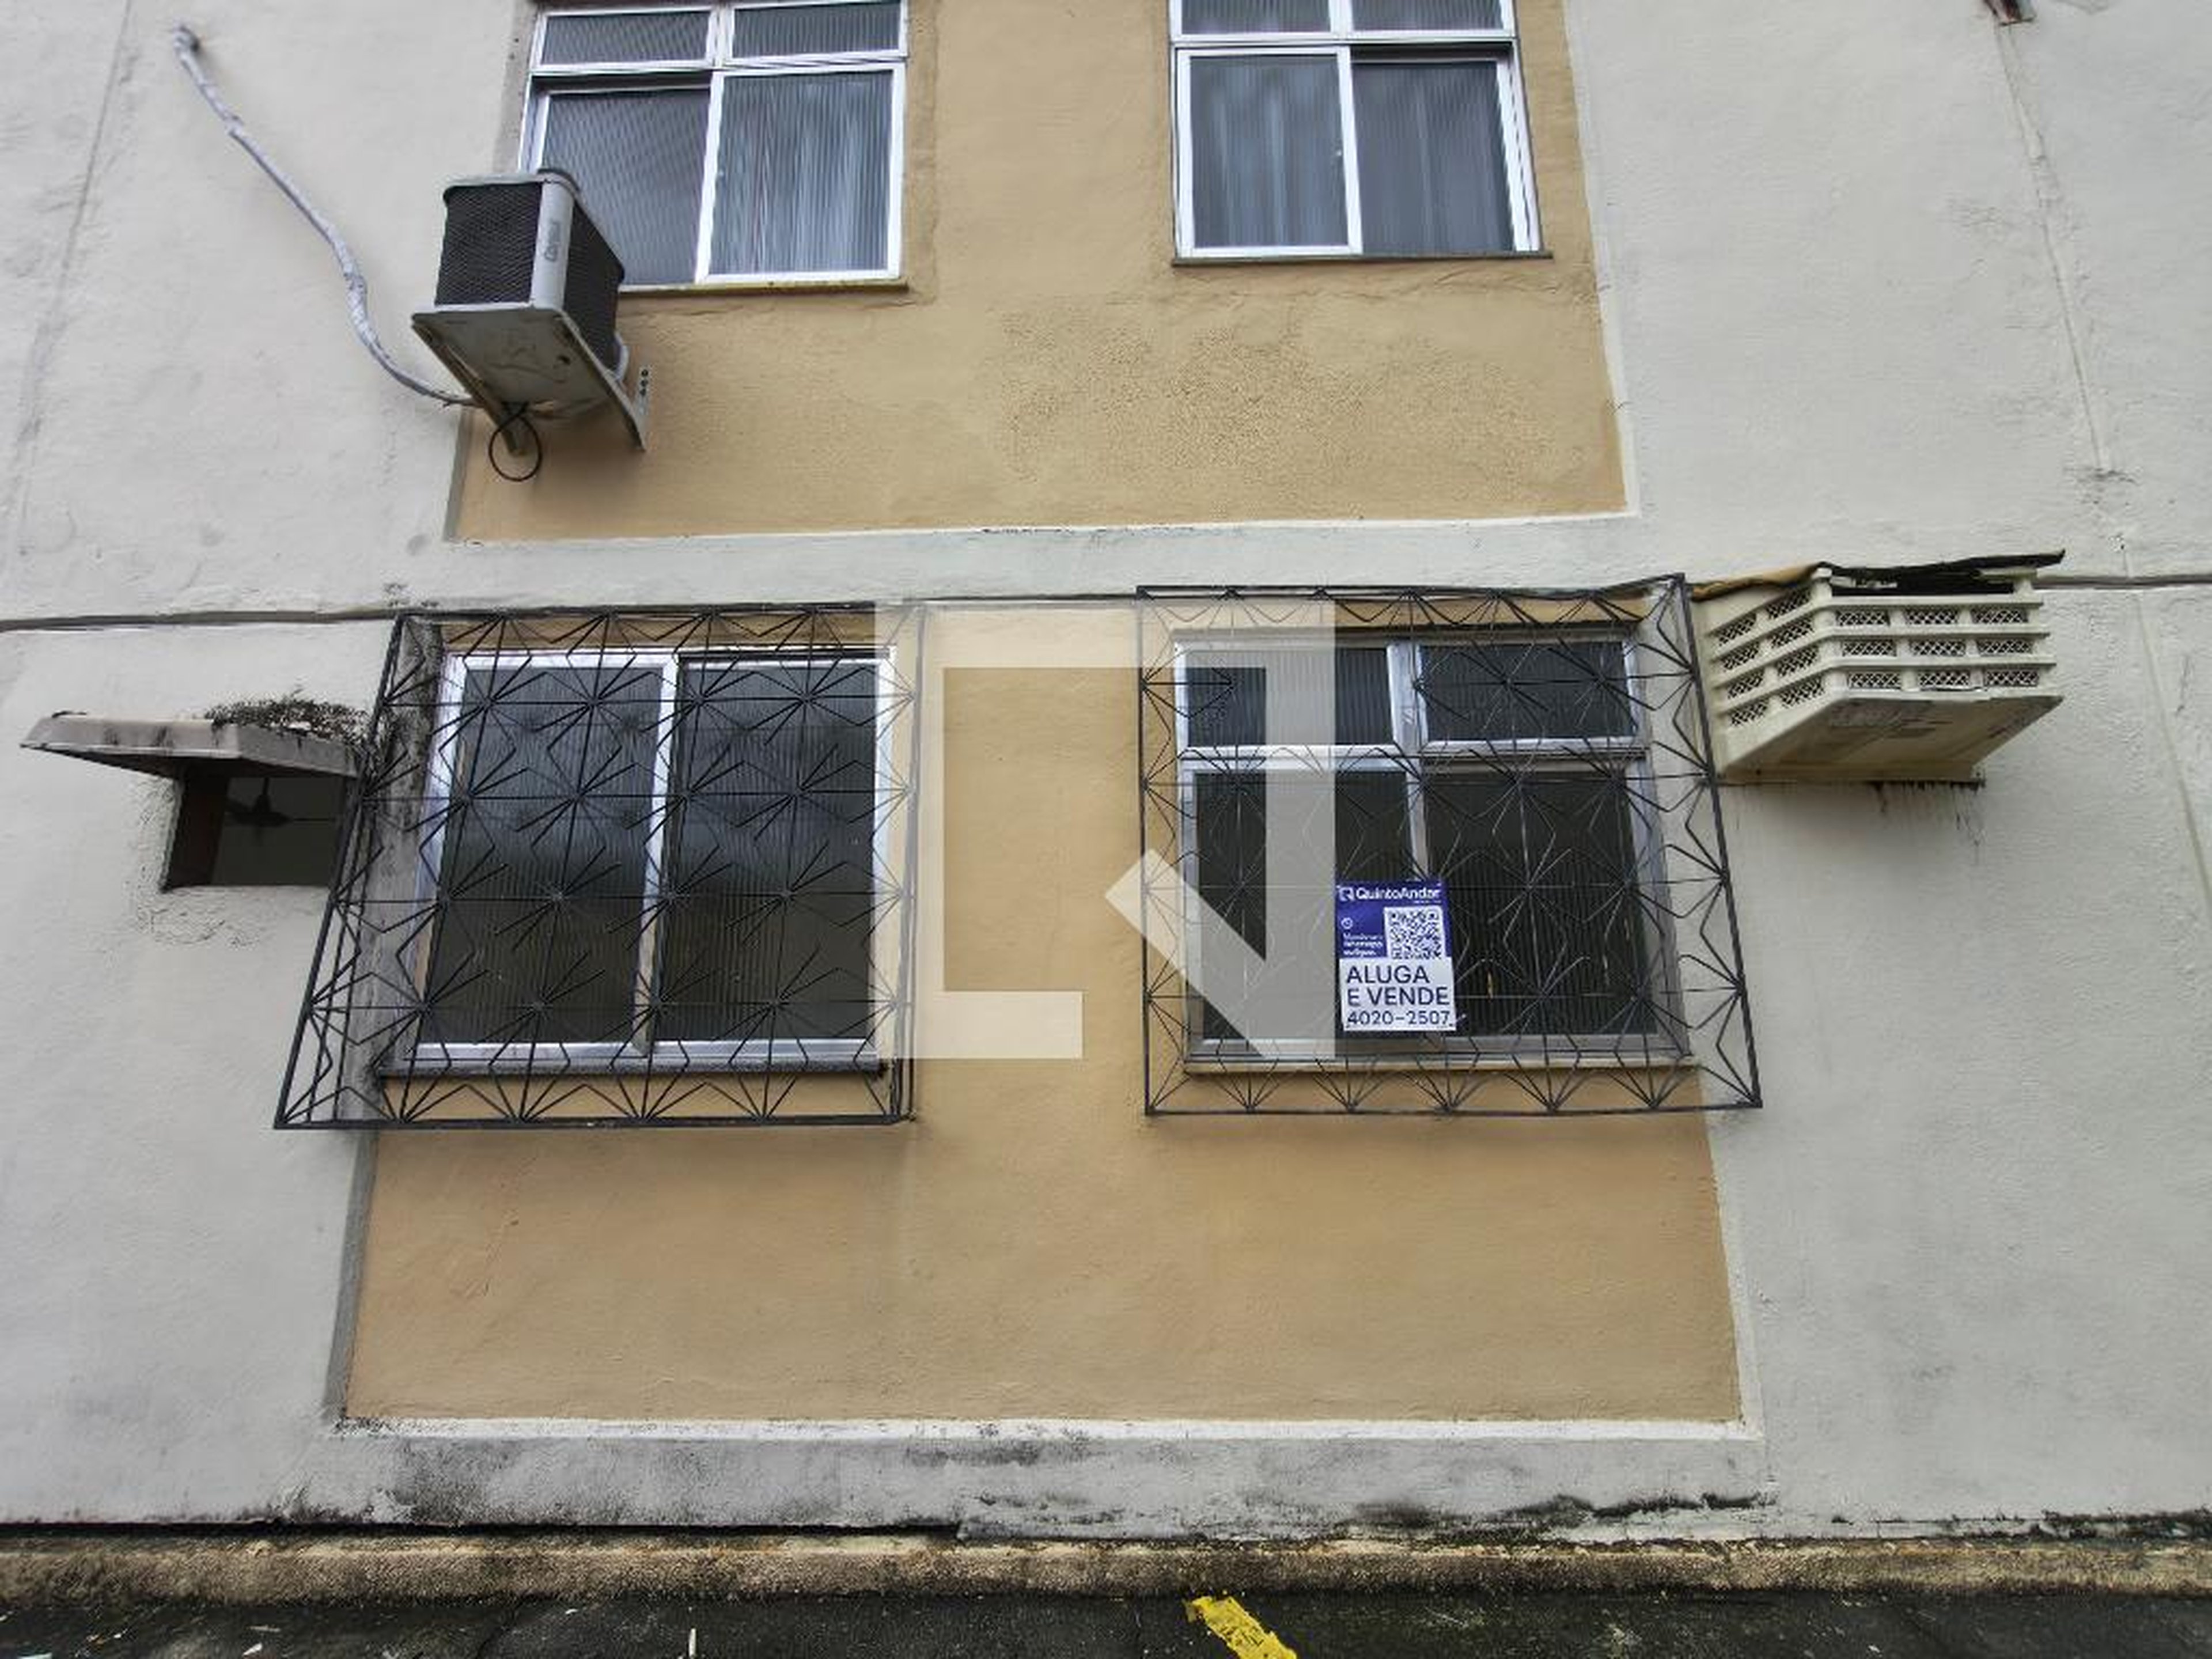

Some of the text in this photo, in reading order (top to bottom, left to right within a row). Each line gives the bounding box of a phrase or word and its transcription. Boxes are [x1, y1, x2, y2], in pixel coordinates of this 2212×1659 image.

[1355, 887, 1441, 900] QuintoAndar
[1346, 965, 1430, 983] ALUGA
[1348, 987, 1450, 1006] E VENDE
[1347, 1010, 1450, 1025] 4020-2507
